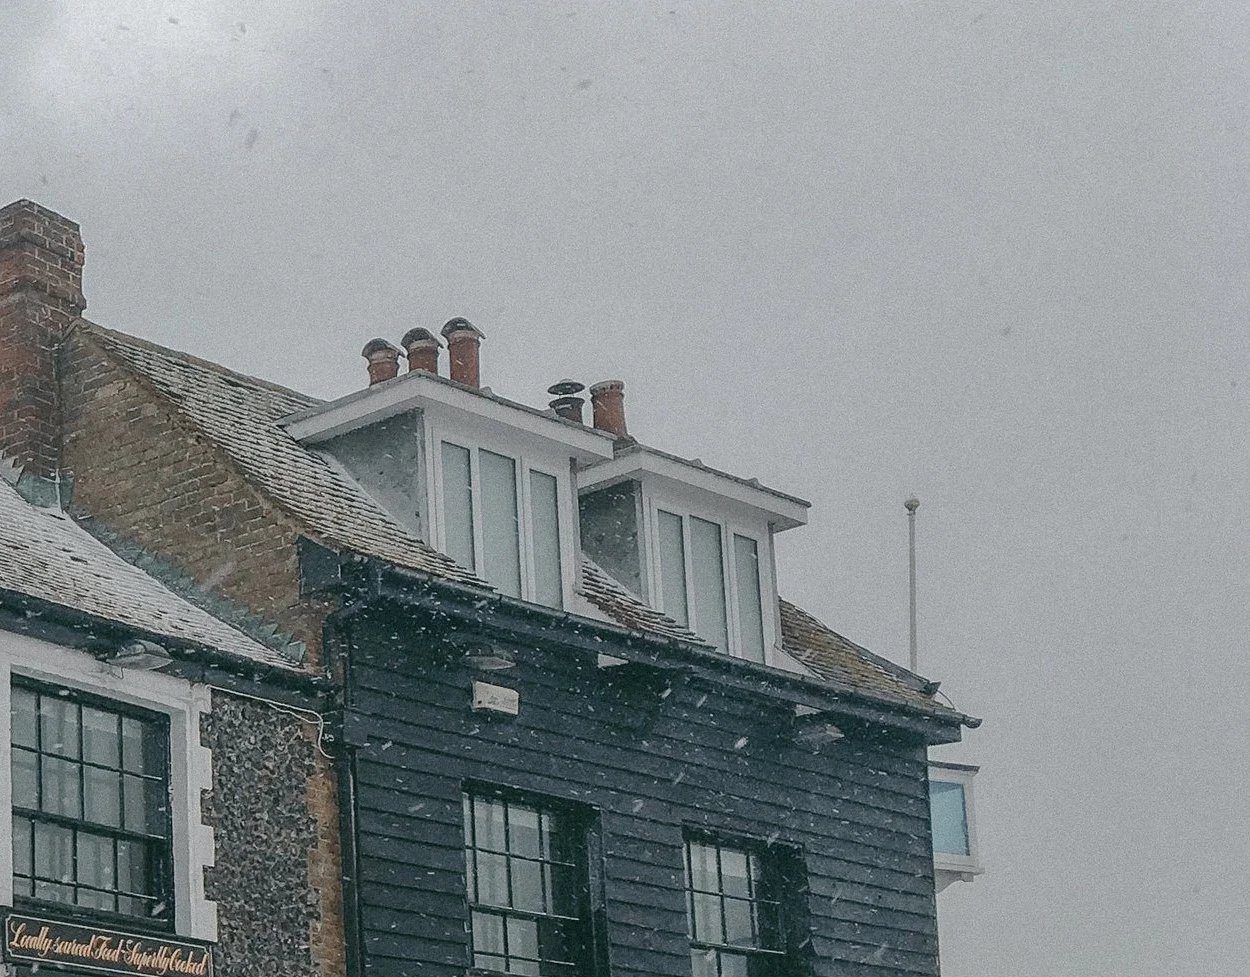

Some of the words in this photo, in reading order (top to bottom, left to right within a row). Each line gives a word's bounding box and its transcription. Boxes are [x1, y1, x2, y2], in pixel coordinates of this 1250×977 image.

[9, 921, 54, 957] Locally
[51, 934, 95, 958] sourced
[92, 935, 124, 962] Food
[125, 939, 170, 975] Superbly
[169, 948, 208, 976] Cooked
